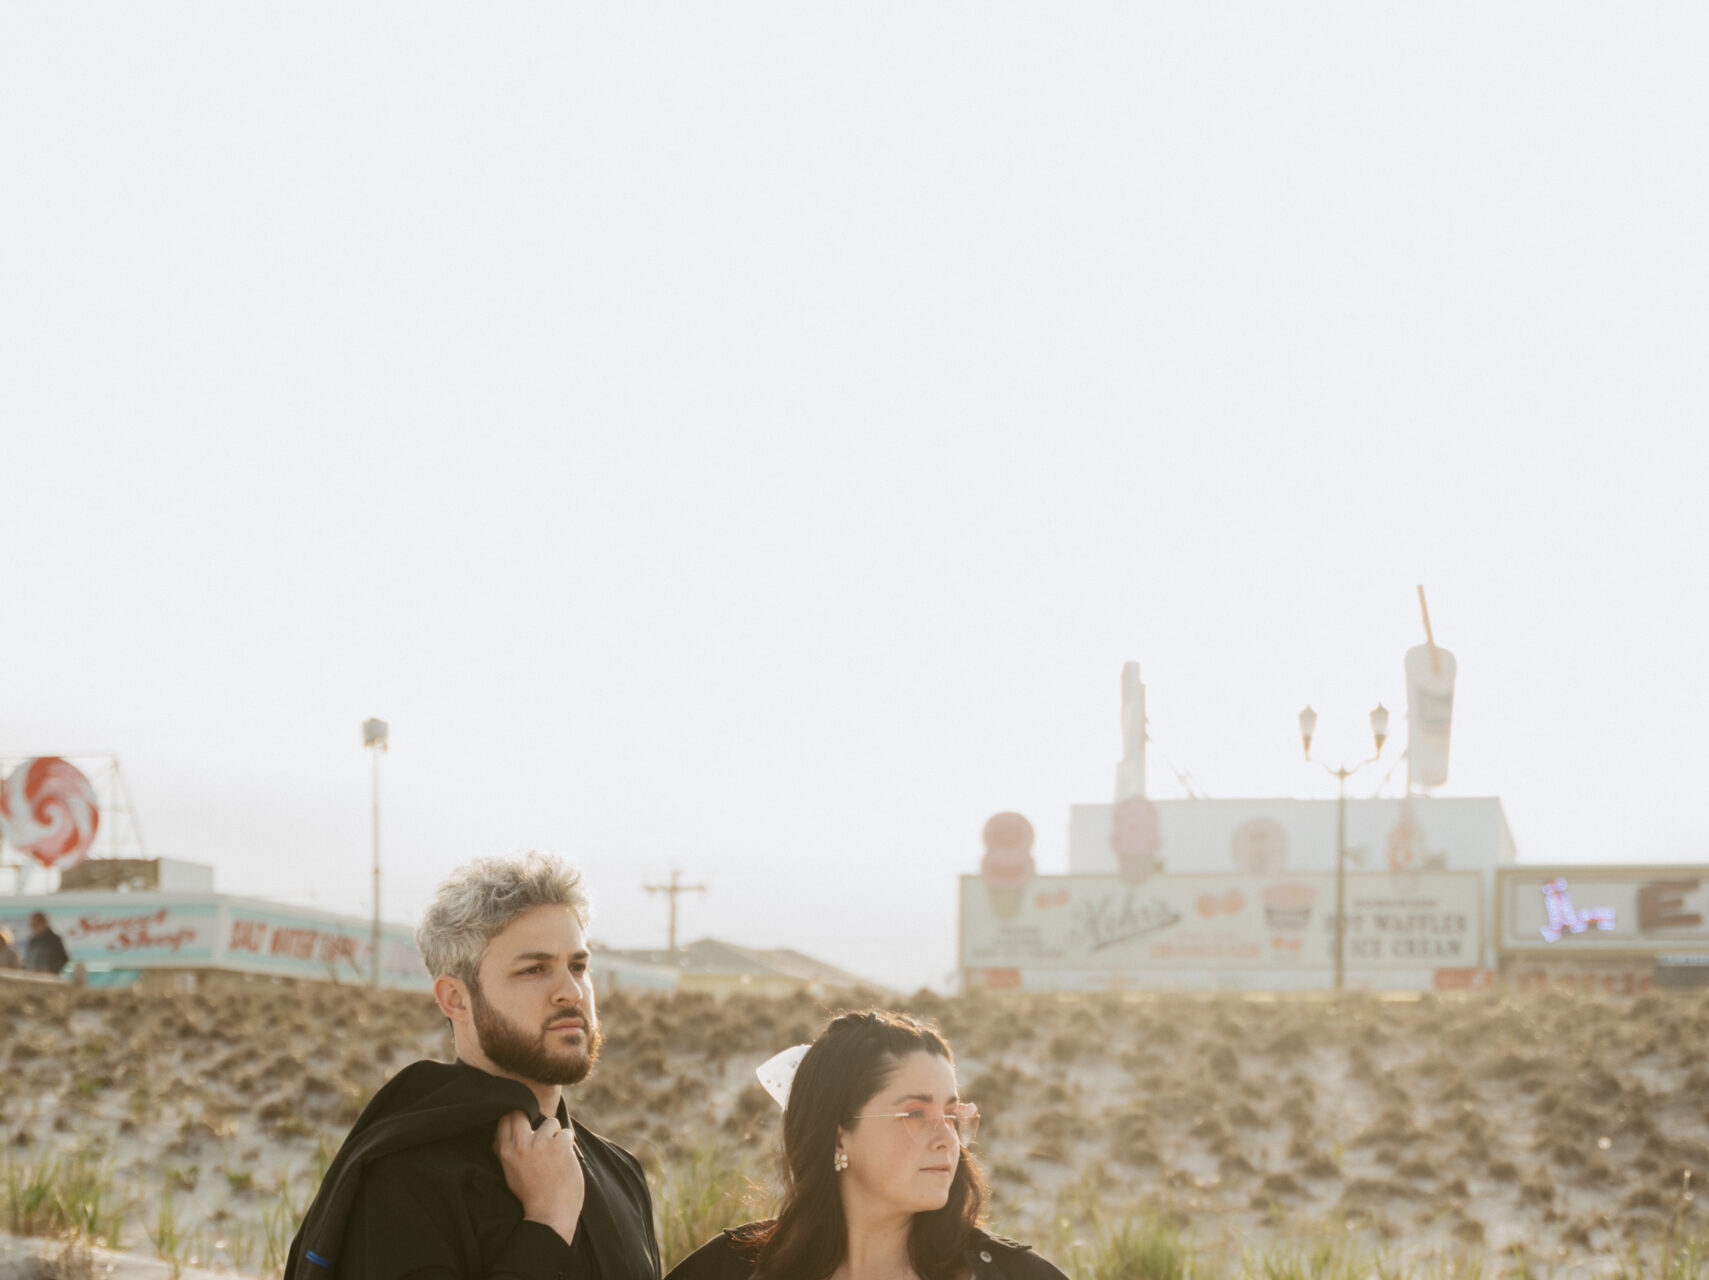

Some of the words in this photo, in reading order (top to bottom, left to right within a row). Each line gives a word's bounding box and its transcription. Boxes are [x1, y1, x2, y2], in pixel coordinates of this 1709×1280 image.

[67, 906, 169, 941] Sweet
[107, 923, 196, 955] Shop
[1375, 912, 1467, 934] WAFFLES
[229, 920, 267, 952] SALT
[271, 927, 318, 960] WATER
[1392, 937, 1462, 959] CREAM
